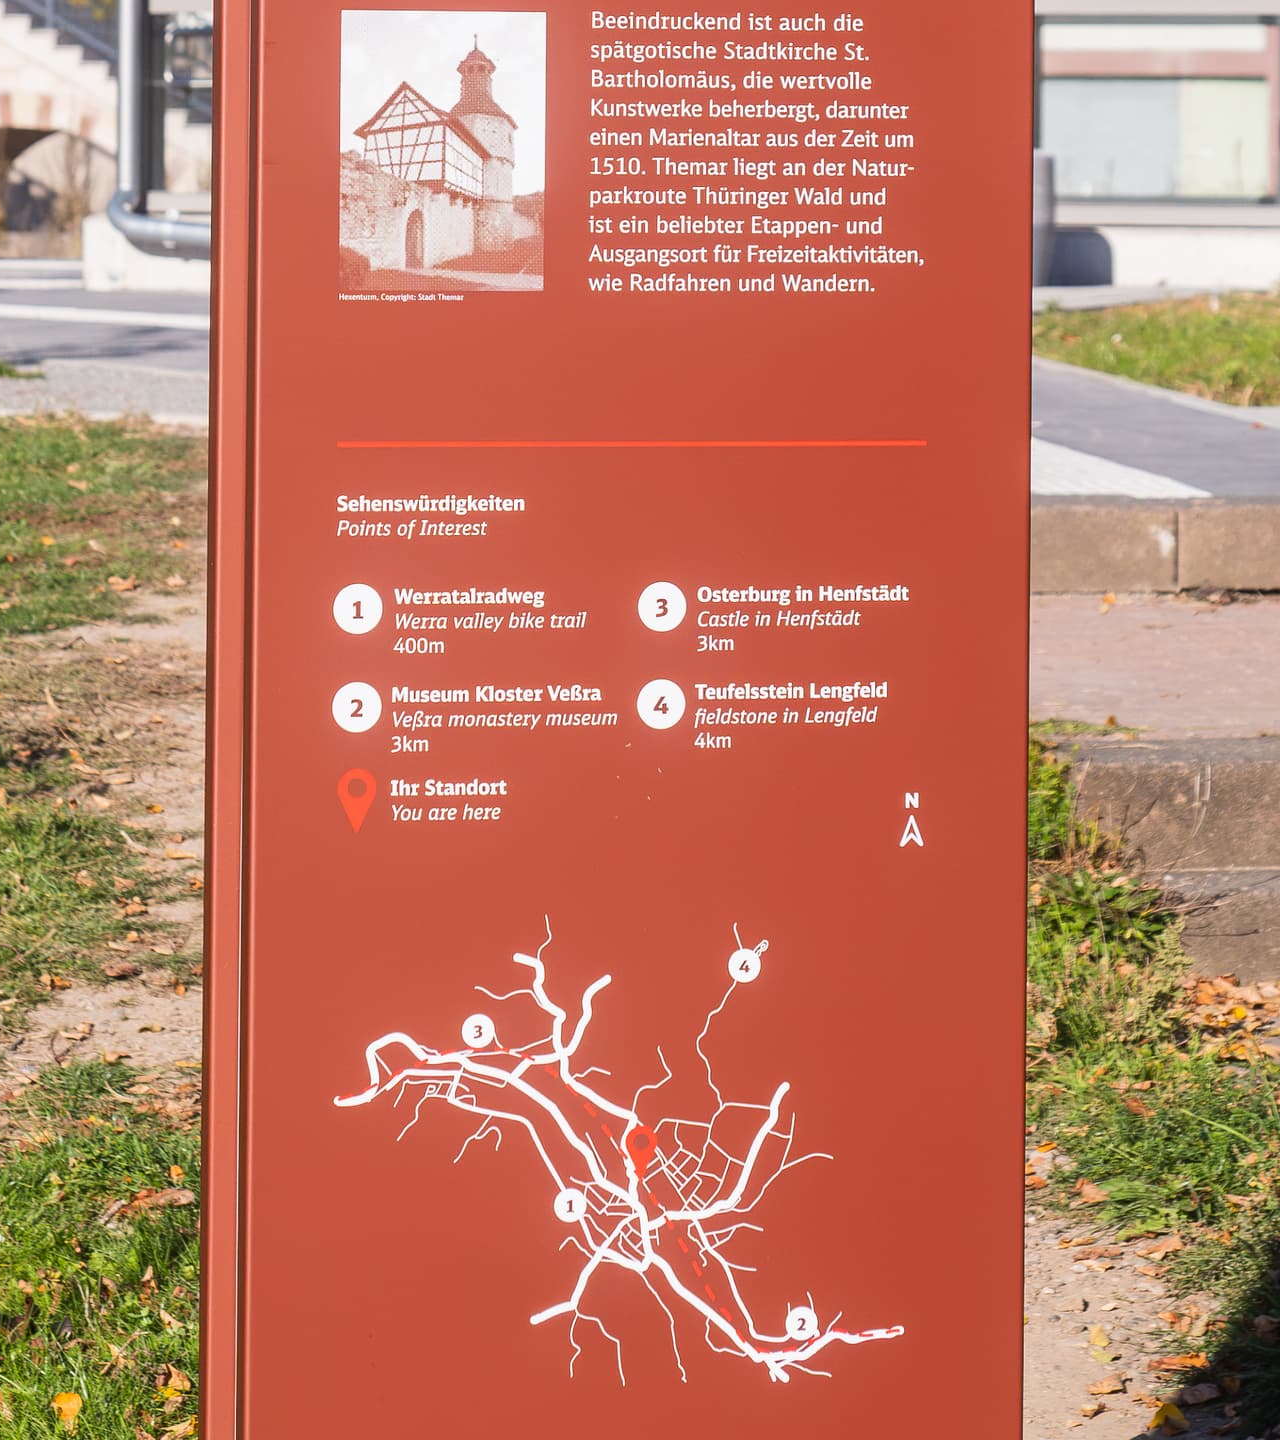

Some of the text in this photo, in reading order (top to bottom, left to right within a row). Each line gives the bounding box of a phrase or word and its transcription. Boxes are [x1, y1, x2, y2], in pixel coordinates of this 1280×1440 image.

[591, 10, 864, 32] Beeindruckend ist auch die
[590, 40, 870, 63] spätgotische Stadtkirche St.
[591, 69, 872, 92] Bartholomäus, die wertvolle
[590, 98, 910, 123] Kunstwerke beherbergt, darunter
[590, 156, 915, 180] 1510. Themar liegt an der Natur-
[589, 185, 886, 209] parkroute Thüringer Wald und
[588, 243, 925, 267] Ausgangsort für Freizeitaktivitäten,
[588, 273, 875, 293] wie Radfahren und Wandern.
[336, 494, 525, 515] Sehenswürdigkeiten
[336, 519, 488, 540] Points of Interest
[394, 587, 545, 608] Werratalradweg
[697, 584, 910, 606] Osterburg in Henfstädt
[353, 601, 363, 619] 1
[656, 599, 668, 617] 3
[395, 611, 587, 633] Werra valley bike trail
[697, 609, 862, 630] Castle in Henfstädt
[392, 637, 445, 654] 400m
[697, 634, 735, 652] 3km
[391, 684, 602, 703] Museum Kloster Veßra
[694, 681, 888, 702] Teufelsstein Lengfeld
[351, 700, 362, 717] 2
[654, 697, 668, 714] 4
[392, 710, 618, 731] Veßra monastery museum
[694, 705, 878, 729] fieldstone in Lengfeld
[390, 735, 429, 753] 3km
[694, 732, 732, 749] 4km
[390, 778, 508, 797] Ihr Standort
[904, 792, 920, 809] N
[391, 803, 501, 822] You are here
[739, 960, 750, 973] 4
[473, 1025, 483, 1039] 3
[567, 1199, 573, 1213] 1
[797, 1317, 806, 1331] 2
